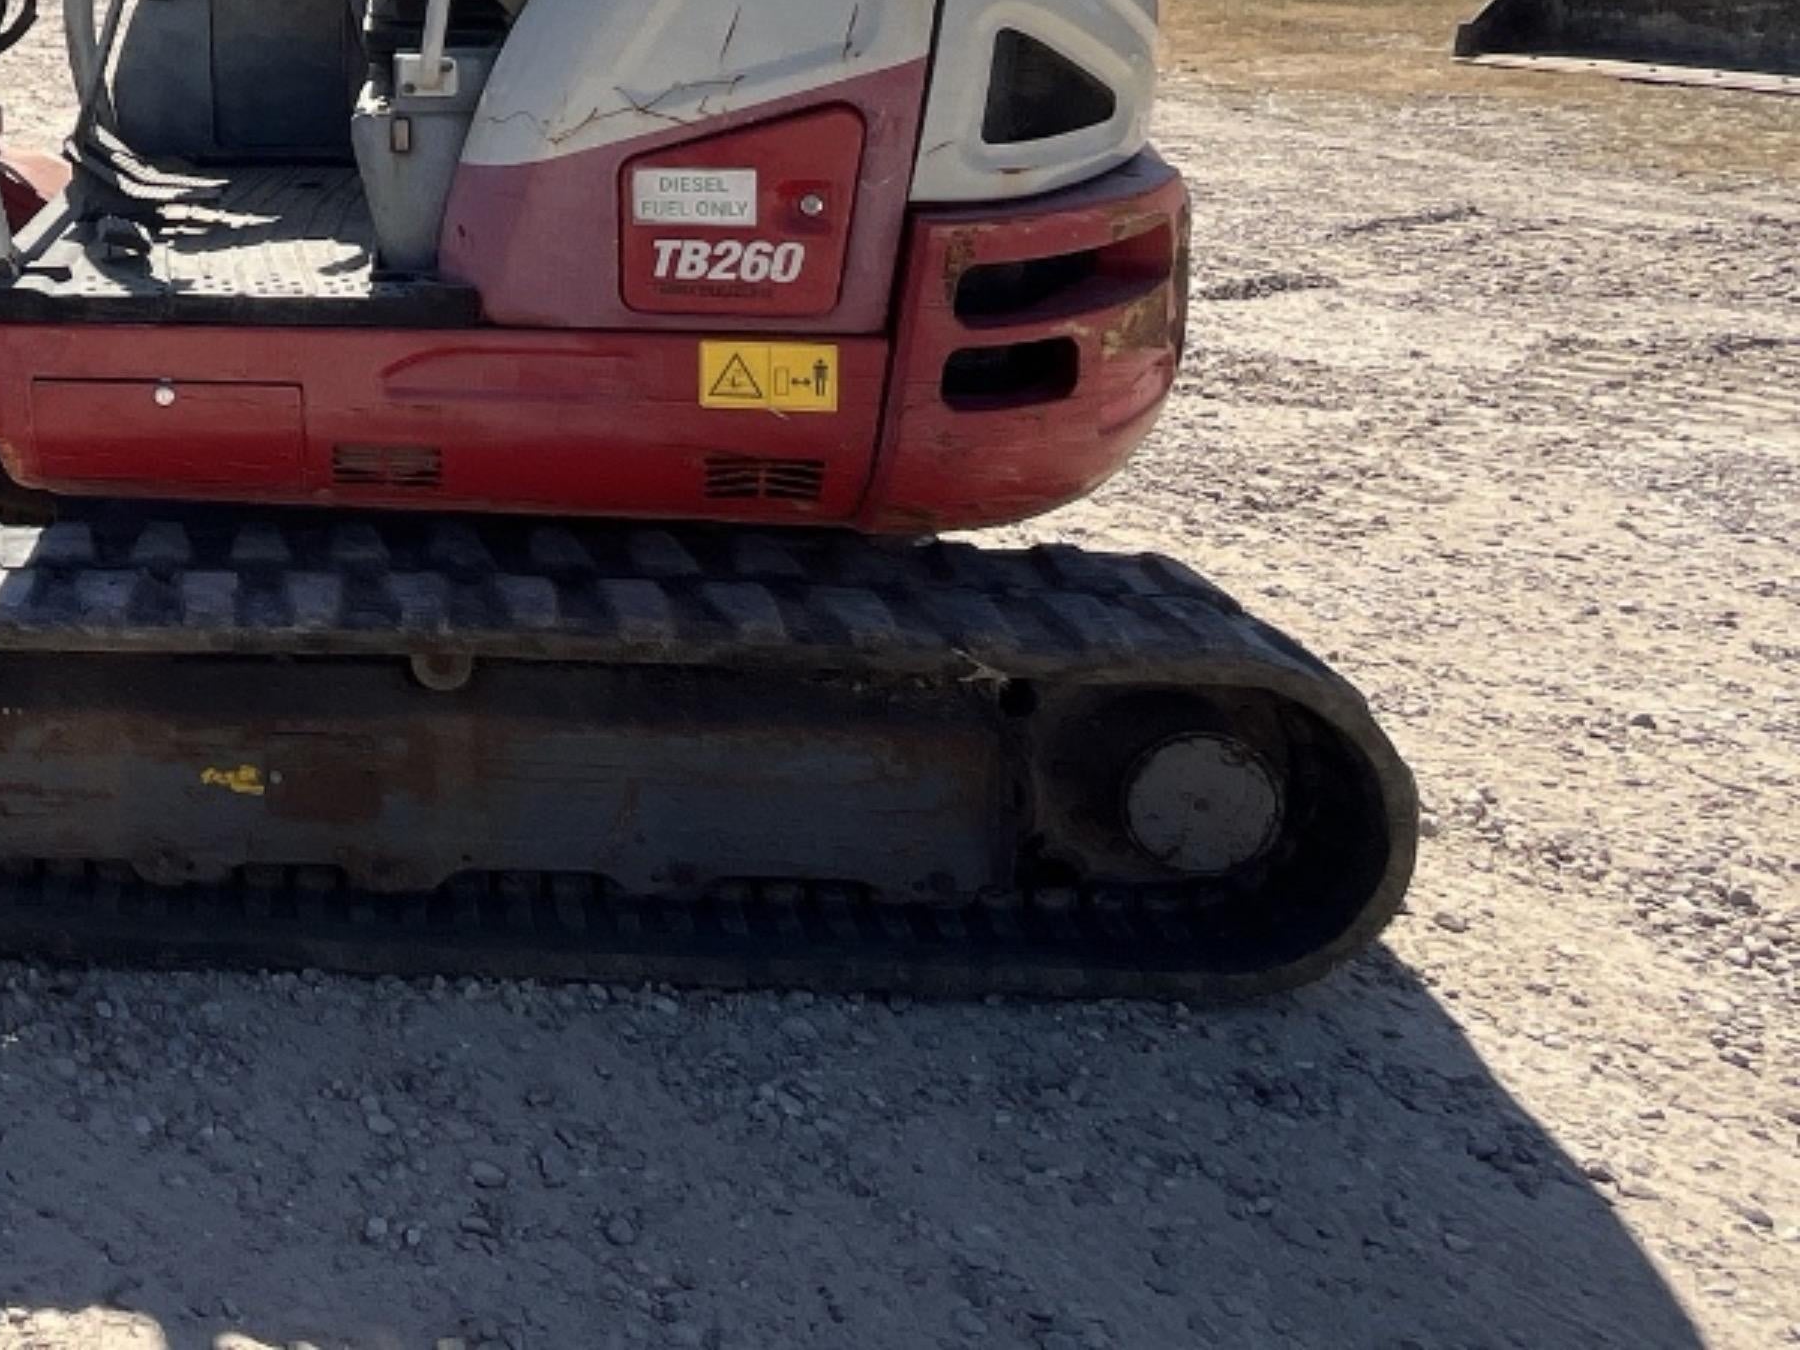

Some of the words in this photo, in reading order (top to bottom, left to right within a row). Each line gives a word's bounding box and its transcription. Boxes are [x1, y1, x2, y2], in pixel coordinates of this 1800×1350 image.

[659, 176, 730, 193] DIESEL
[641, 200, 691, 217] FUEL
[695, 201, 748, 217] ONLY
[652, 238, 805, 283] TB260
